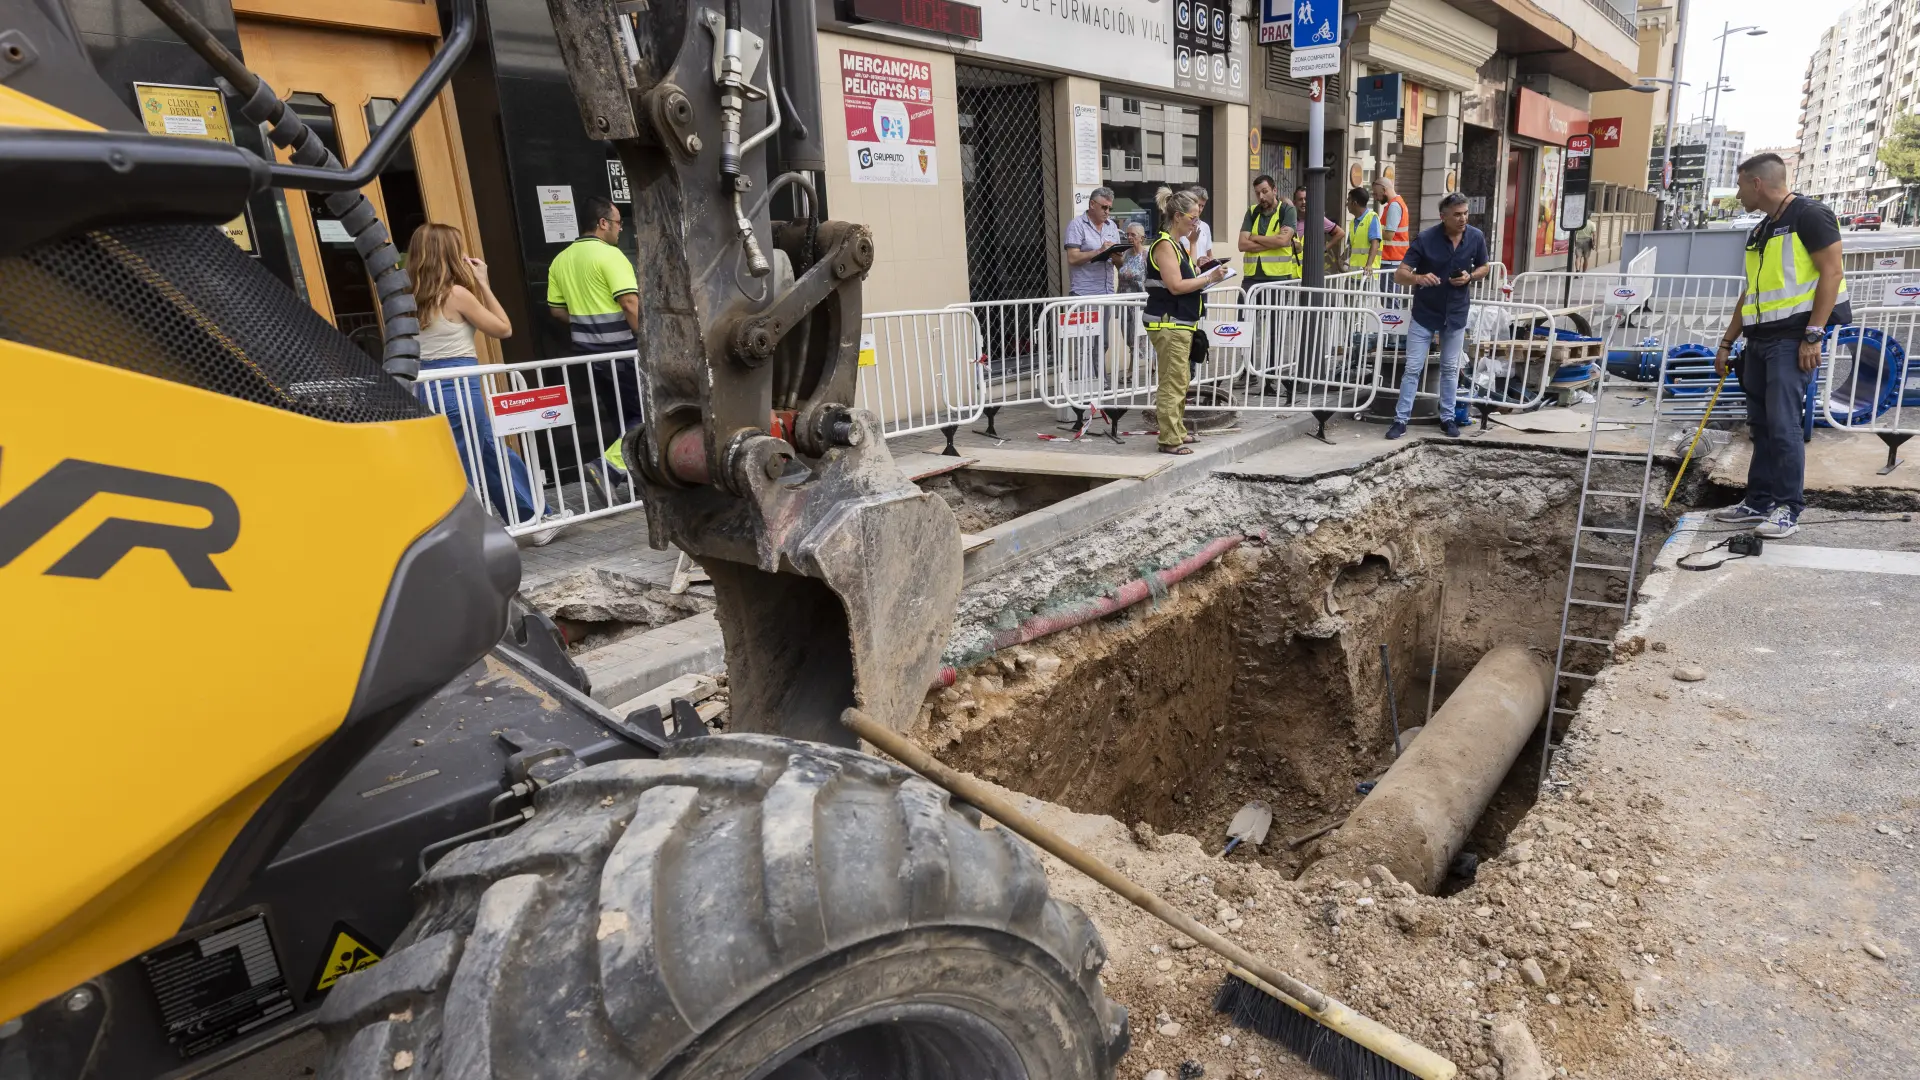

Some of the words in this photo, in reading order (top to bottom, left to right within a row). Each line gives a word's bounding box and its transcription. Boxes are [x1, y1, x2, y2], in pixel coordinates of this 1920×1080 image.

[1050, 0, 1135, 36] FORMACIÓN
[1142, 18, 1168, 44] VIAL
[1307, 53, 1335, 62] COMPARTIDA
[1292, 64, 1315, 72] PRIORIDAD
[1315, 62, 1338, 71] PEATONAL
[167, 98, 200, 109] CLÍNICA
[169, 107, 202, 117] DENTAL
[851, 127, 868, 137] CENTRO
[1572, 139, 1588, 148] BUS
[1567, 157, 1579, 168] 31
[610, 163, 620, 176] SE
[509, 397, 535, 406] Zaragoza
